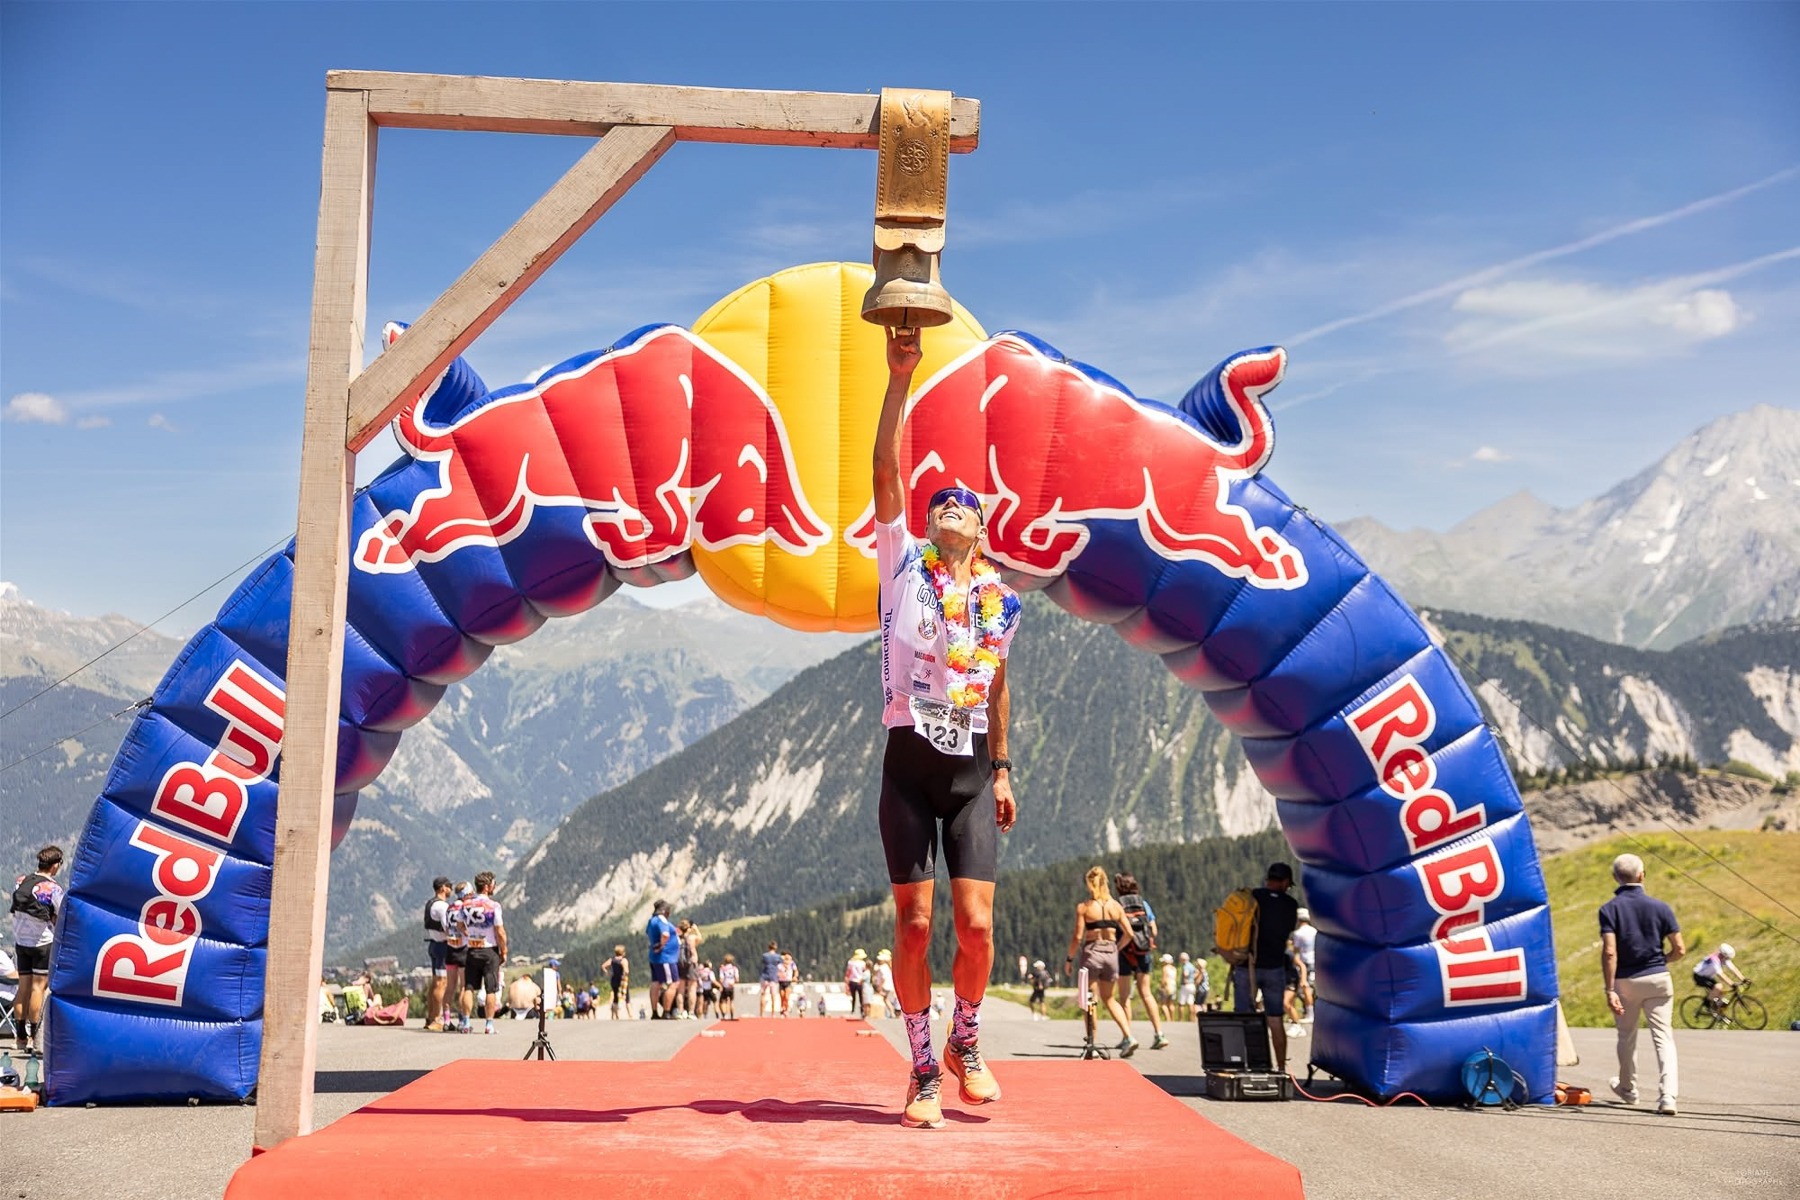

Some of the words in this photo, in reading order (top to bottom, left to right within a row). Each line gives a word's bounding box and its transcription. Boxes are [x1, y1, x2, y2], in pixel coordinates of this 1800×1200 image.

[884, 608, 893, 681] COURCHEVEL
[922, 722, 959, 748] 123
[463, 906, 486, 925] X3
